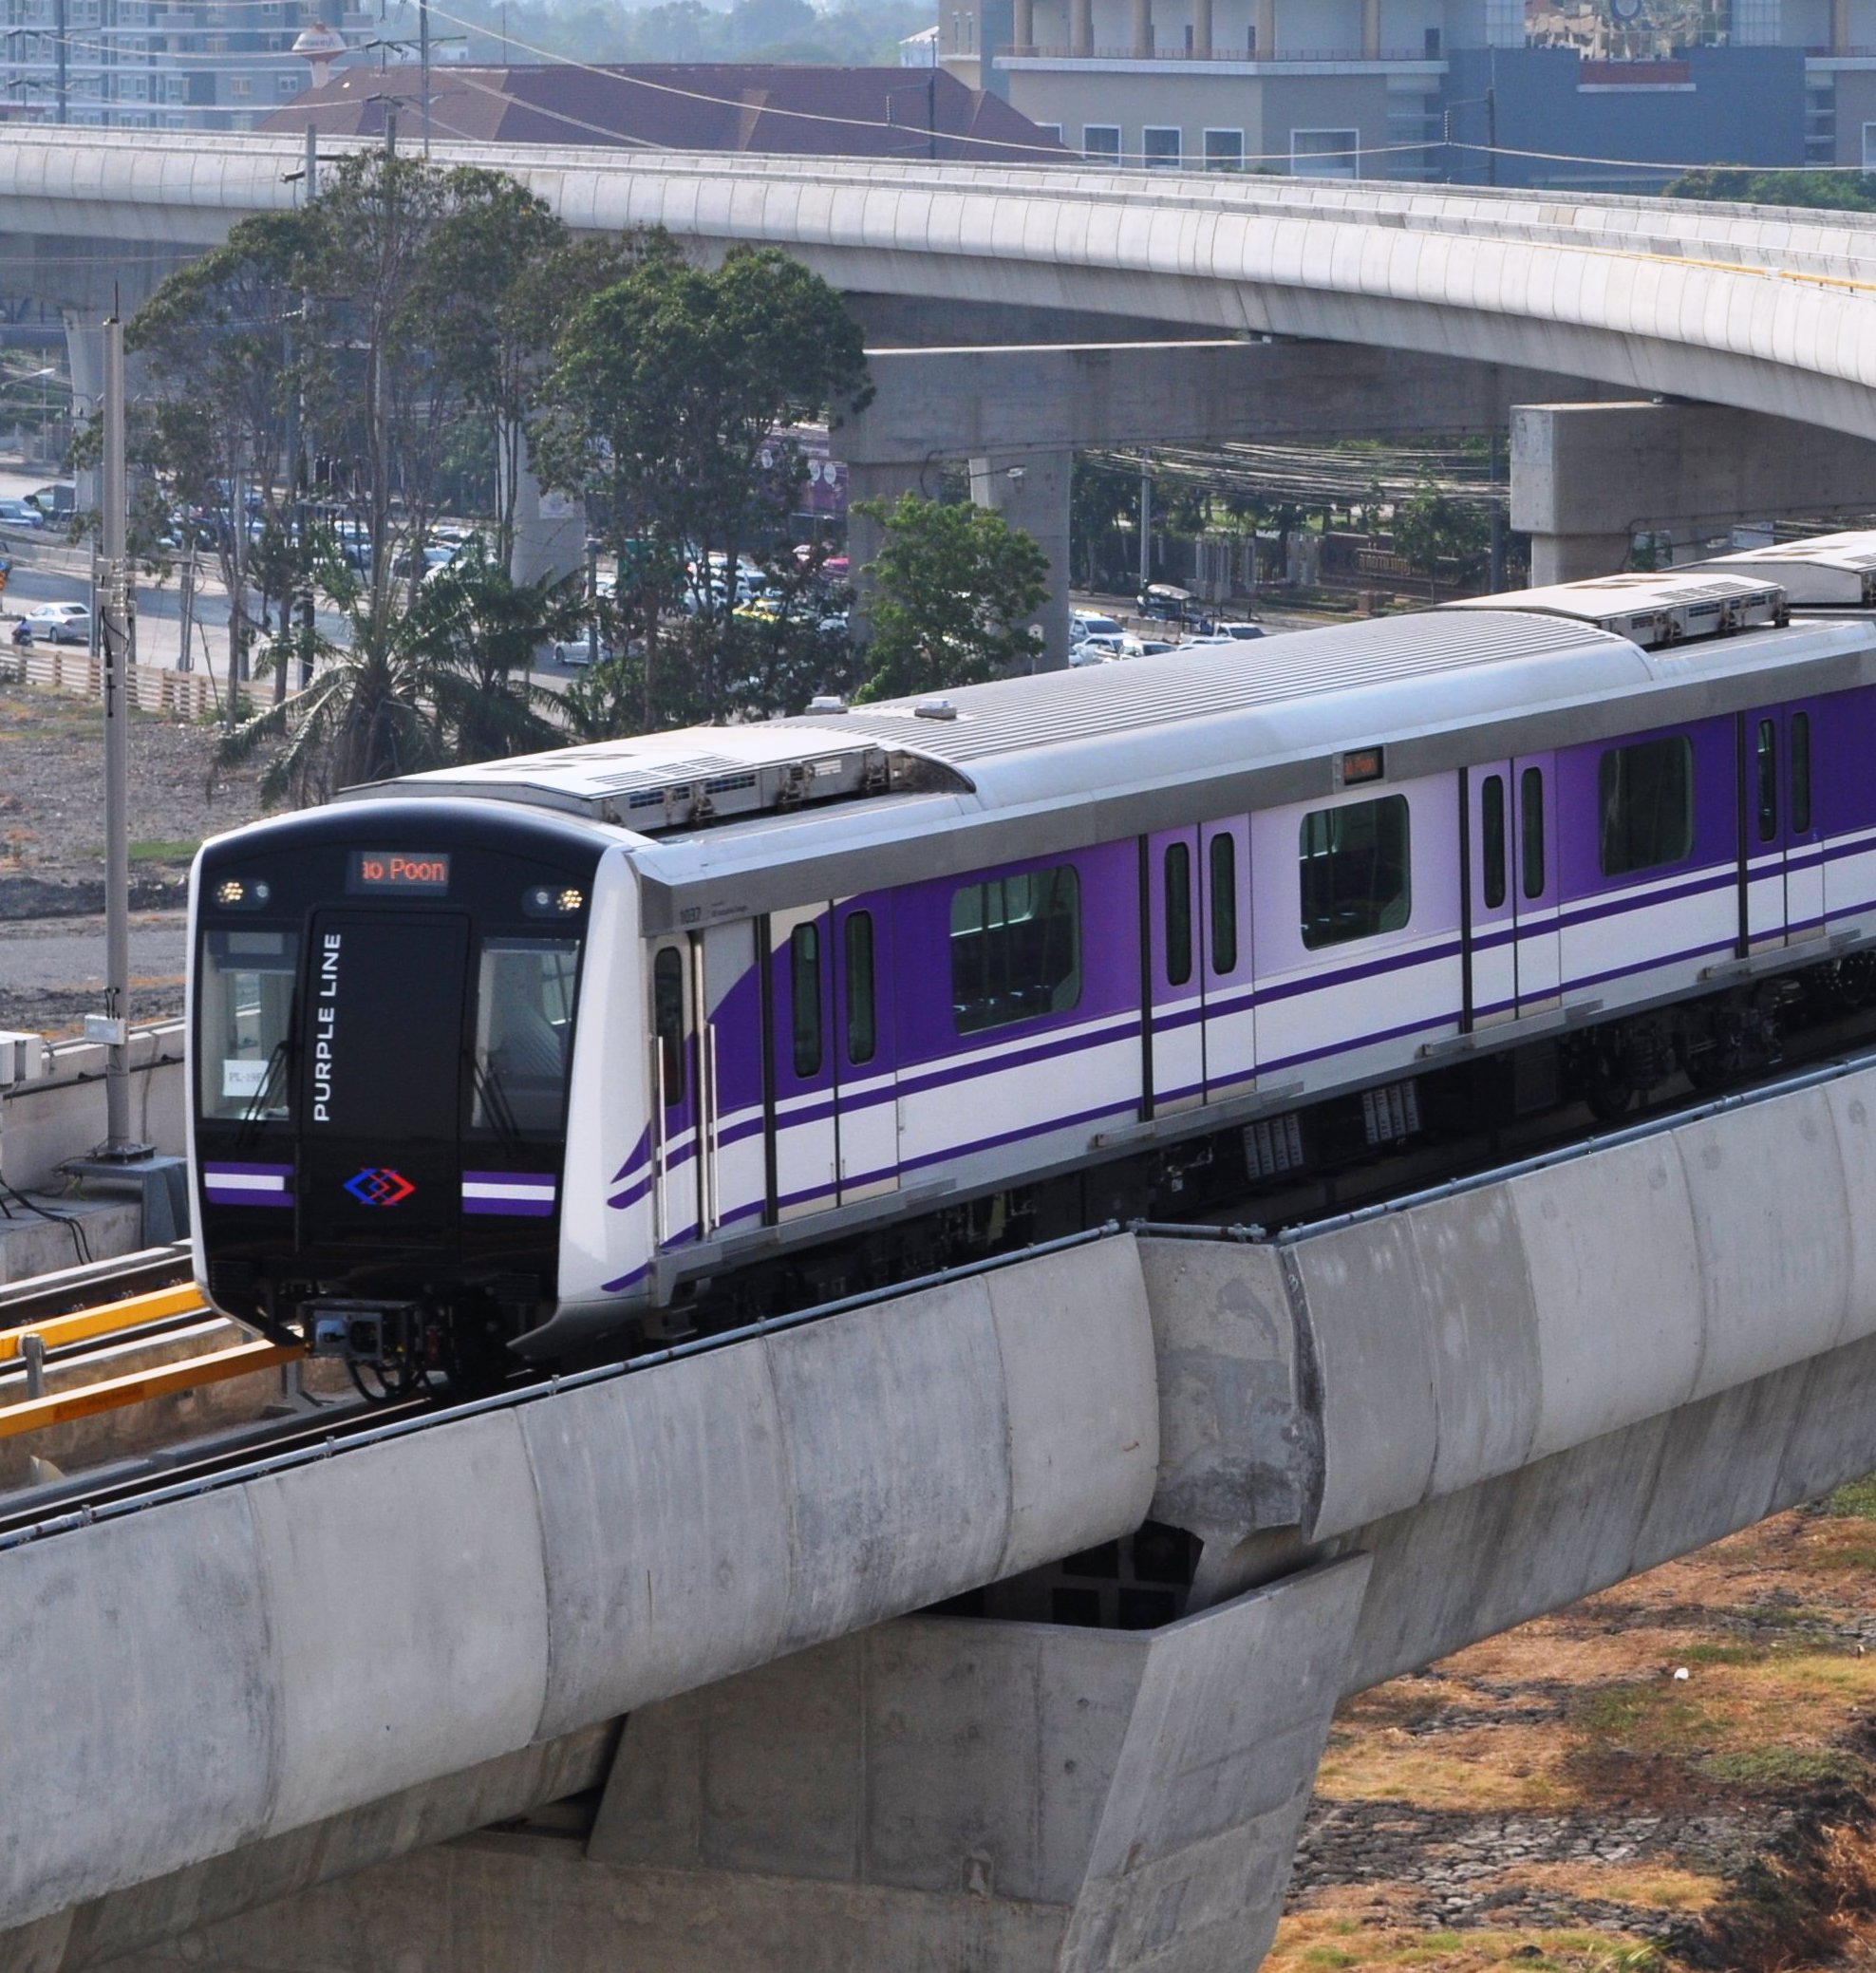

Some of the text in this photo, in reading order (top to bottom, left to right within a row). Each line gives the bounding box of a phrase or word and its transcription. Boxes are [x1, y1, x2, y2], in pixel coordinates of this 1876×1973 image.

[390, 857, 445, 881] Poon
[313, 934, 341, 1121] PURPLE LINE
